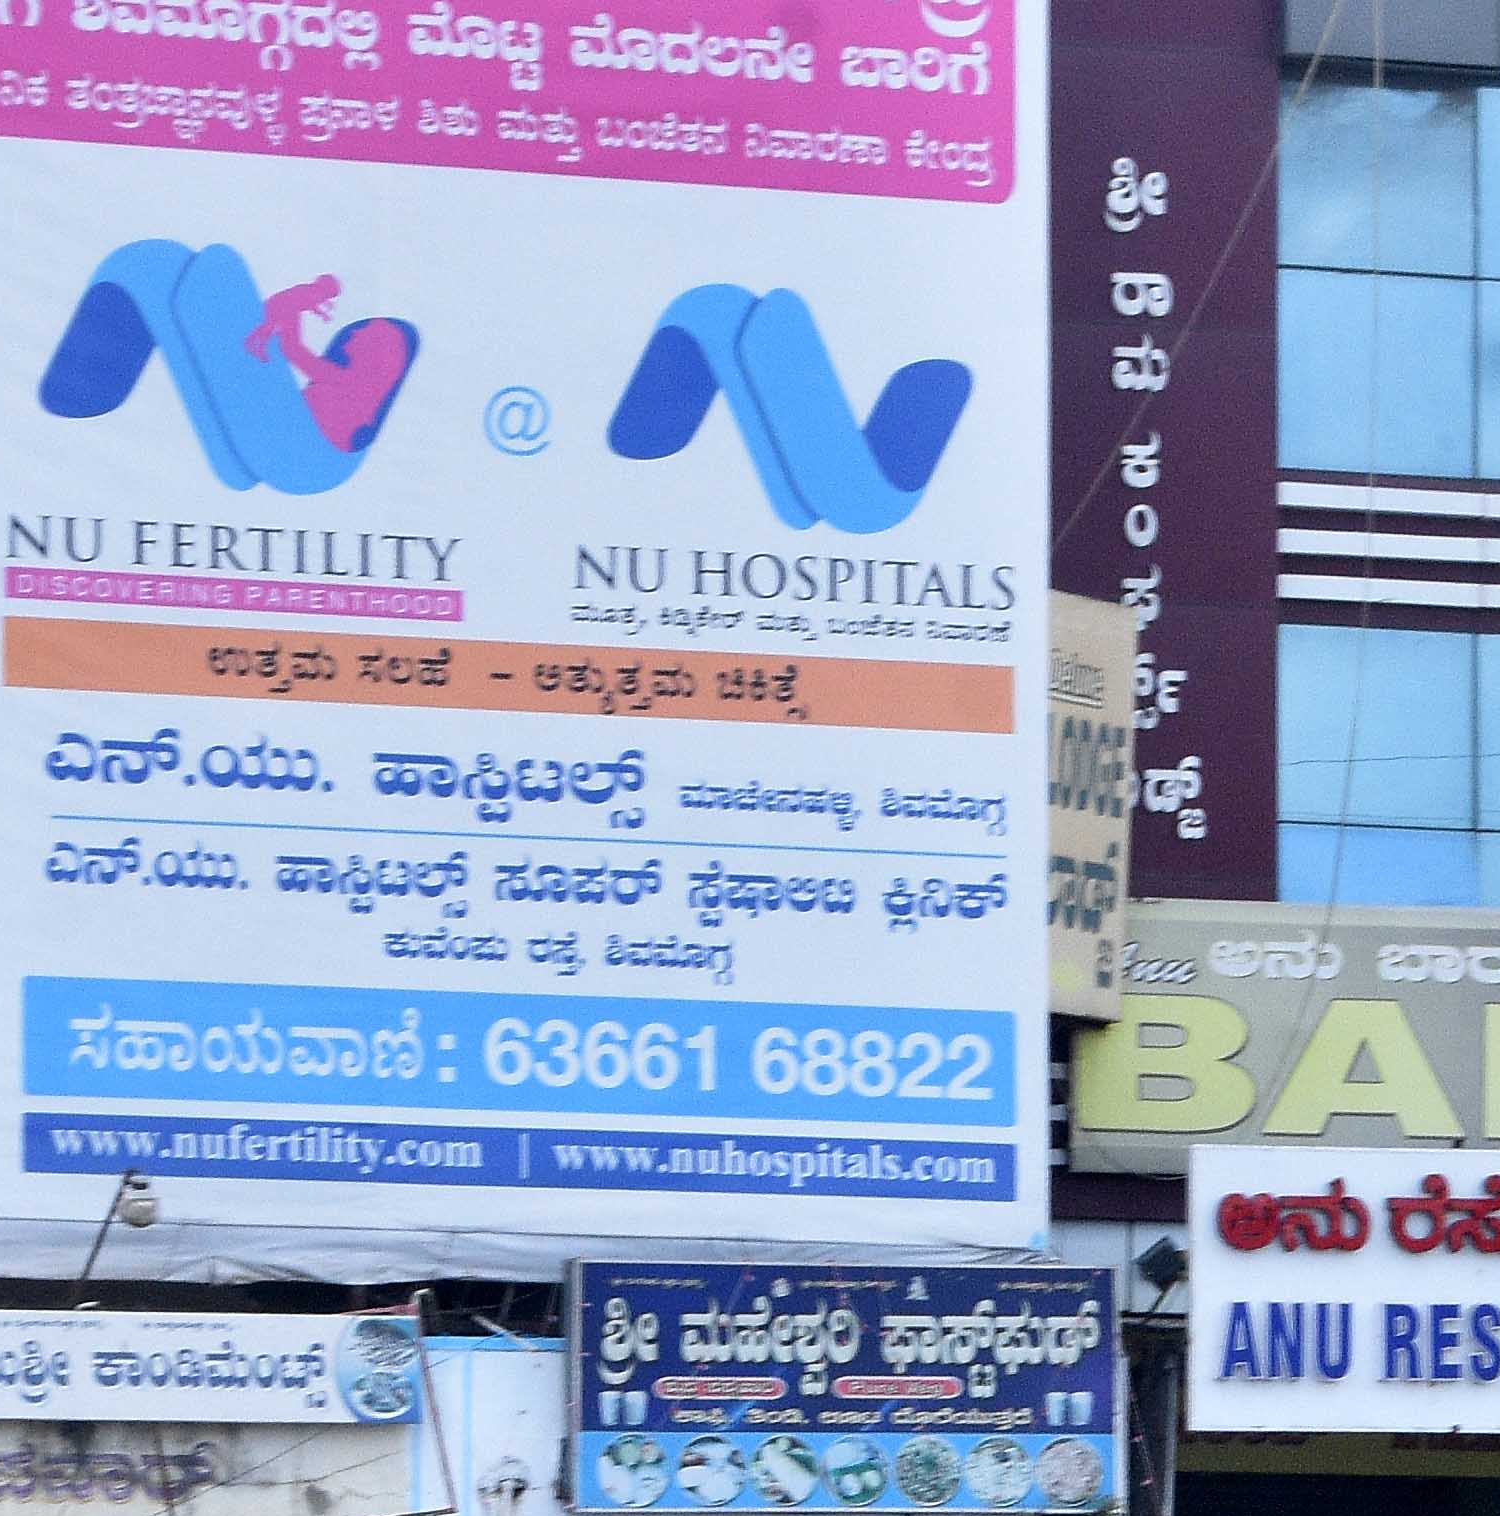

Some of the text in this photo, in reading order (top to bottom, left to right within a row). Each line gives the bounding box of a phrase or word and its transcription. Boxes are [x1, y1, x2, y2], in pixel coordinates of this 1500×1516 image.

[407, 0, 544, 92] ಮೊಟ್ಟ
[569, 12, 816, 83] ಮೊದಲನೇ
[841, 42, 992, 96] ಬಾರಿಗೆ
[496, 104, 585, 164] ಮತ್ತು
[904, 128, 996, 188] ಕೇಂದ್ರ
[482, 385, 554, 458] @
[5, 514, 464, 582] NU FERTILITY
[572, 544, 1019, 612] NU HOSPITALS
[15, 573, 454, 617] DISCOVERING PARENTHOOD
[208, 642, 339, 694] ಉತ್ತಮ
[357, 645, 453, 688] ಸಲಹೆ
[495, 858, 662, 906] ಸೂಪರ್
[882, 873, 1009, 934] ಕ್ಲಿನಿಕ್
[1207, 934, 1343, 981] ಅನು
[483, 1015, 718, 1092] 63661
[751, 1024, 994, 1101] 68822
[51, 1121, 998, 1188] www.nufertility.com www.nuhospitals.com
[1217, 1177, 1371, 1252] ಅನು
[598, 1296, 661, 1387] ಶ್ರೀ
[1219, 1301, 1355, 1381] ANU
